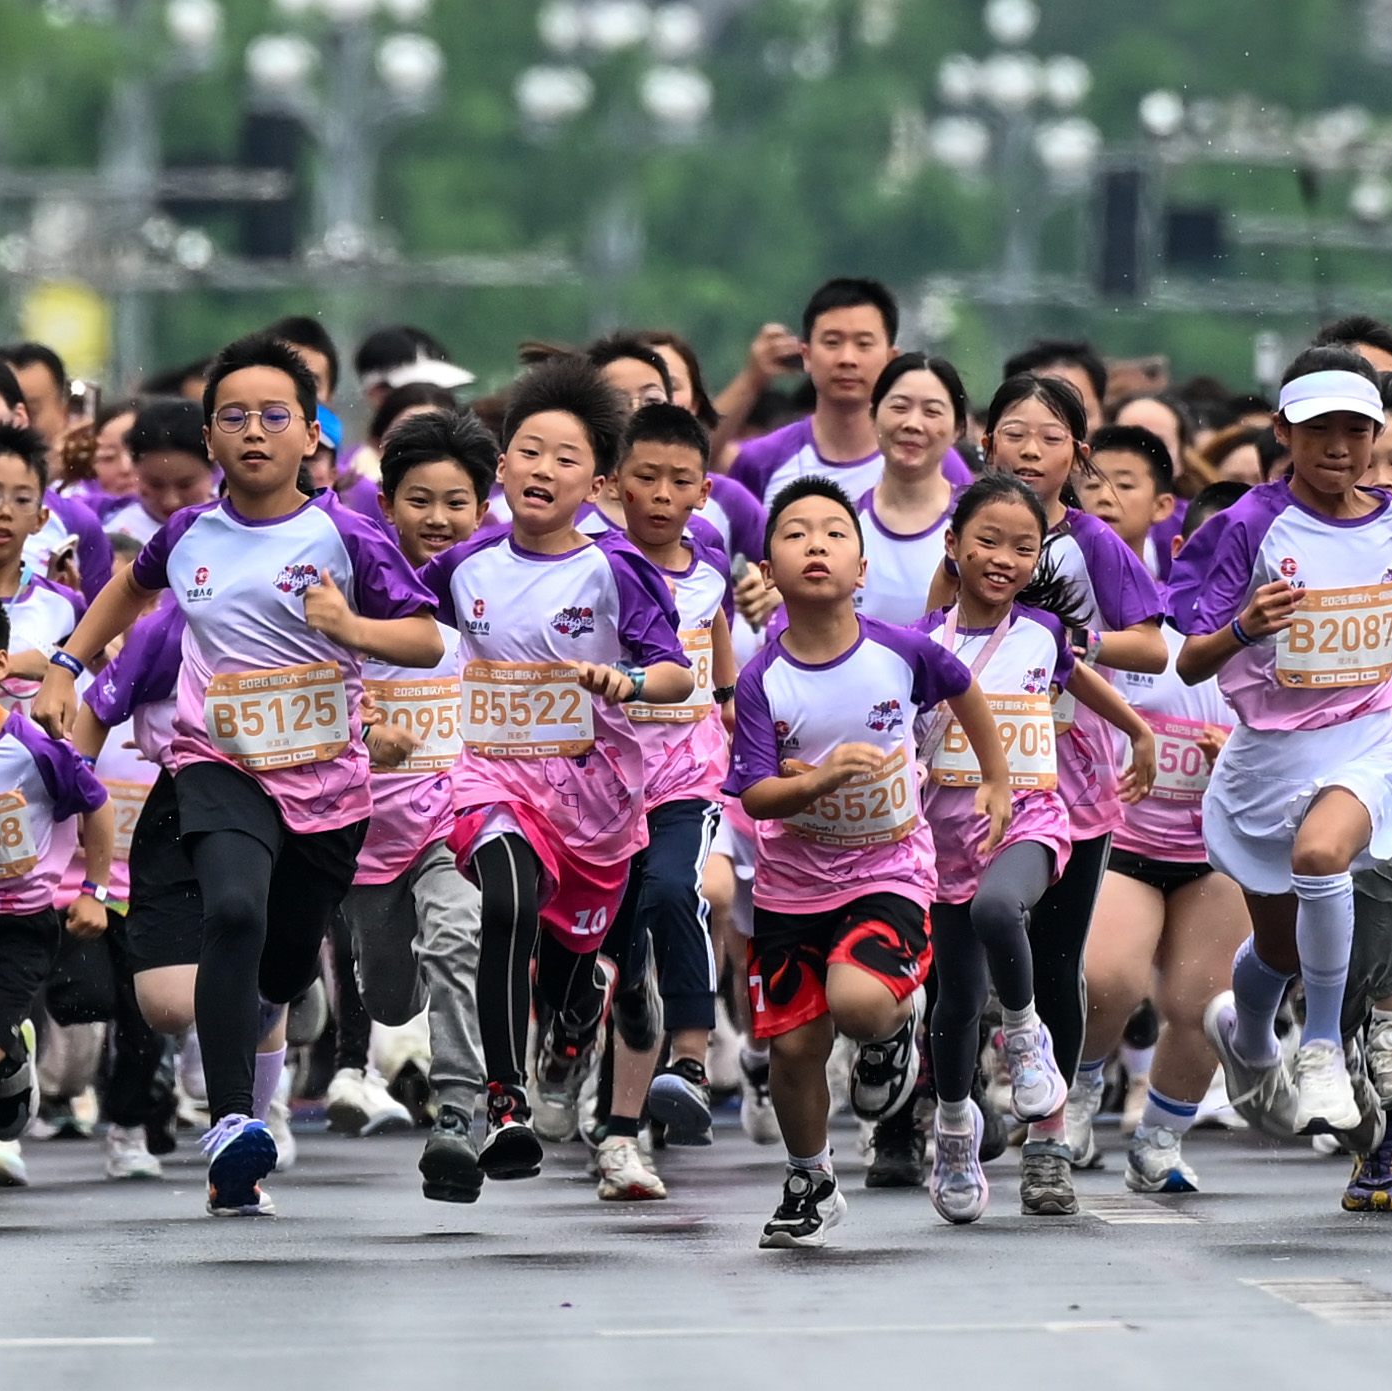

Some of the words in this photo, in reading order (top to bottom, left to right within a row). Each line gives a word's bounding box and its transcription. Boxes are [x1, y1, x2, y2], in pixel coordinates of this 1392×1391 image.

[212, 690, 338, 739] B5125
[372, 704, 462, 741] 095
[469, 689, 583, 727] B5522
[943, 720, 1051, 757] B905
[570, 906, 607, 936] 10
[748, 974, 766, 1013] 7
